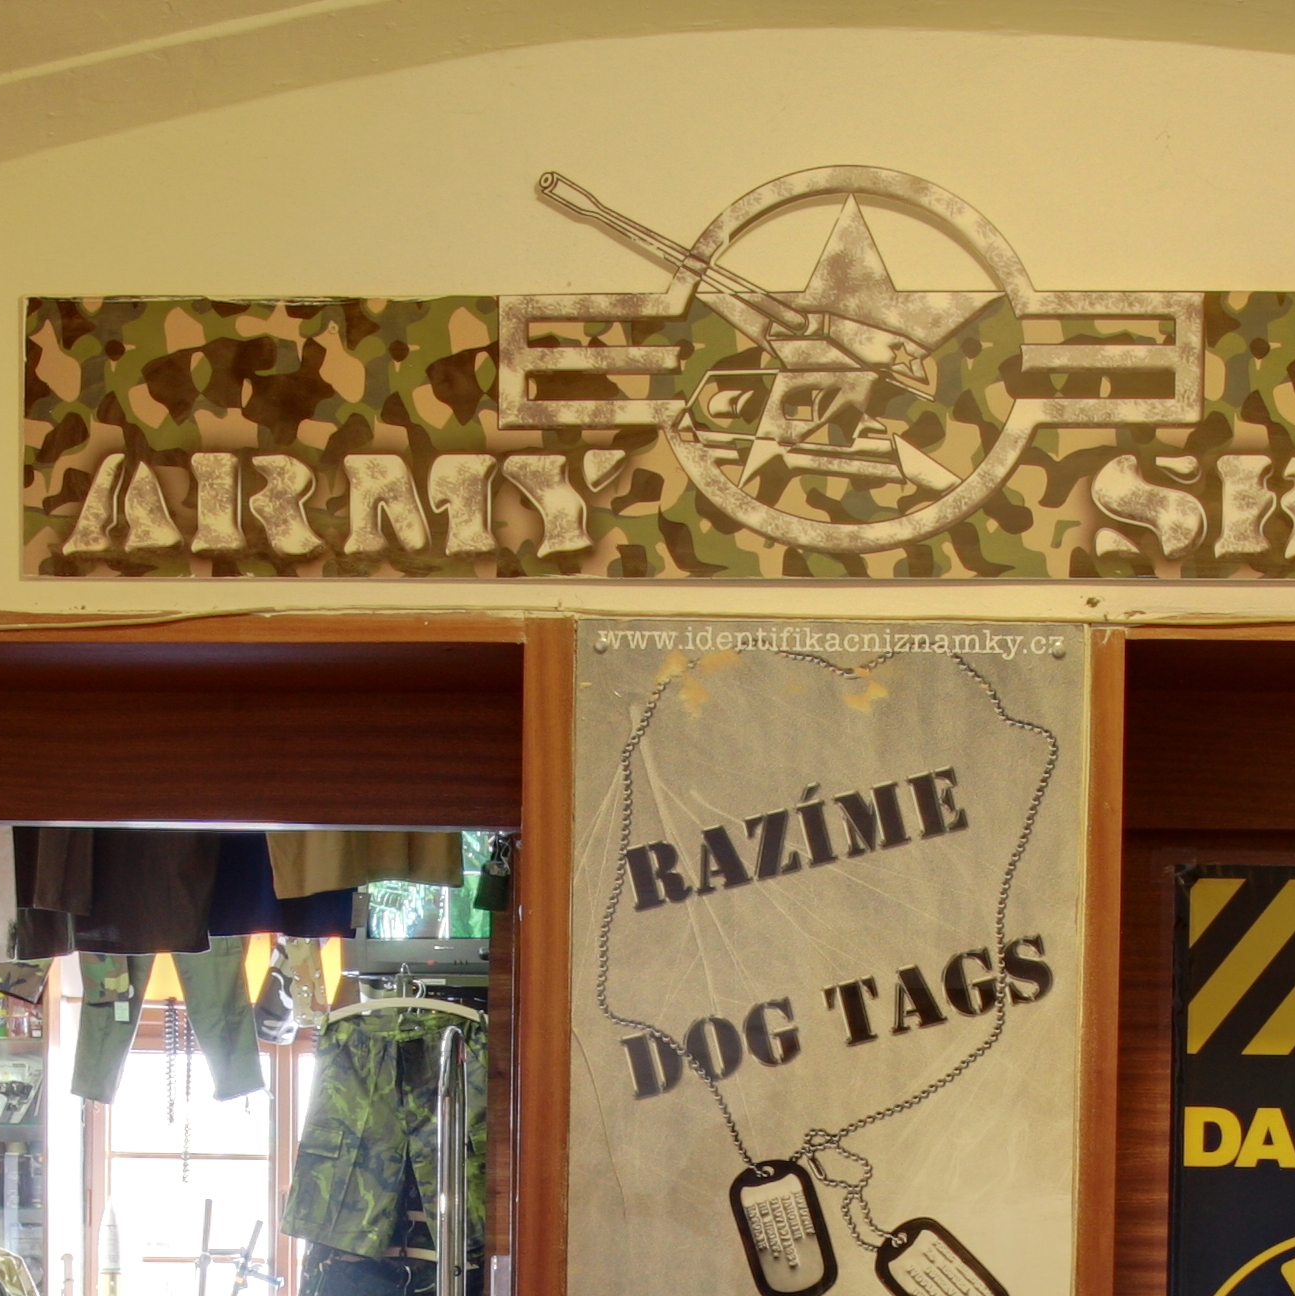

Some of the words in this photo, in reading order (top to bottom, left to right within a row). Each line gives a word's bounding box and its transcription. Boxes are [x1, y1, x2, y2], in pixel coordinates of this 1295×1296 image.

[62, 448, 627, 559] ARMY
[597, 627, 1065, 660] www.identifikacniznamky.cz
[625, 766, 970, 911] RAZÍME
[619, 995, 804, 1100] DOG
[823, 933, 1057, 1047] TAGS
